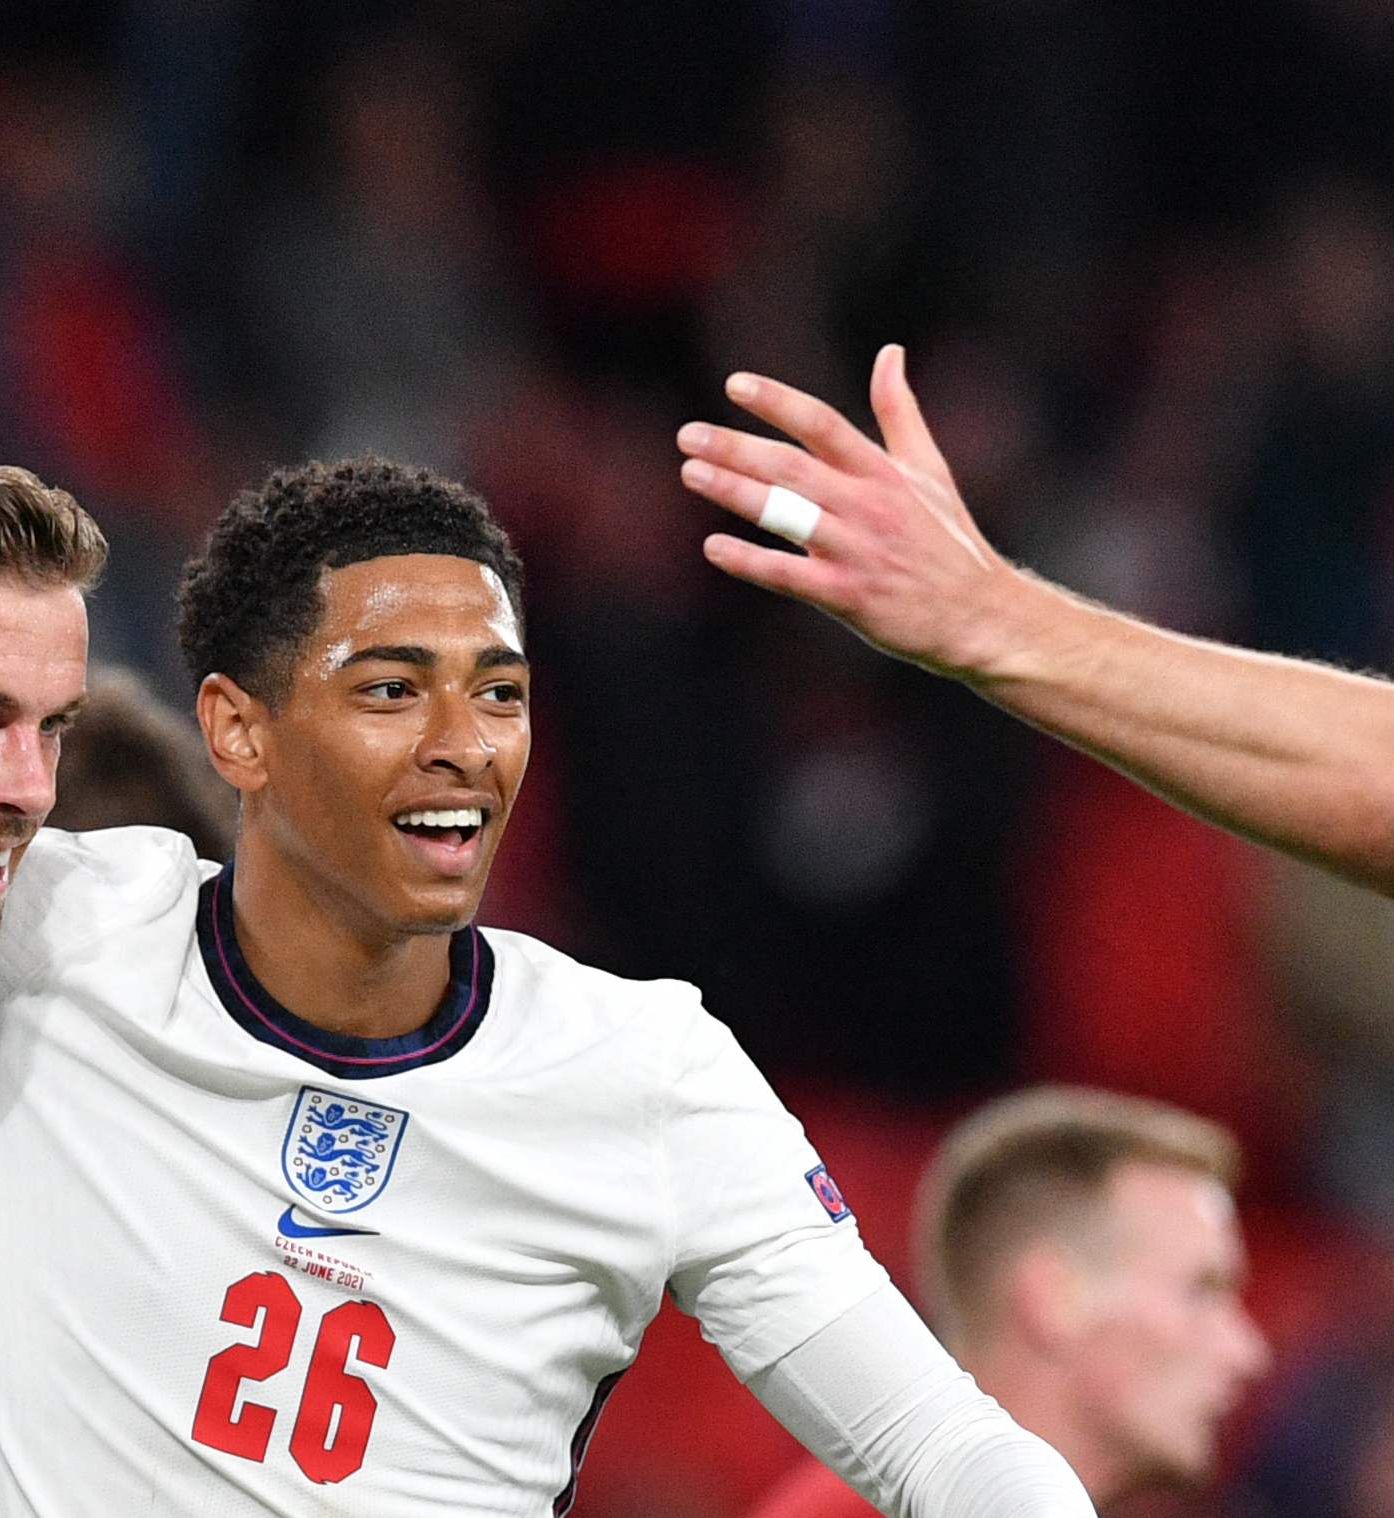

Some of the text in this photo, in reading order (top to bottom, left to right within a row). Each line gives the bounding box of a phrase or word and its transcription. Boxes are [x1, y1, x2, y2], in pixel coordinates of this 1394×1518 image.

[275, 1235, 374, 1280] CZECH REPUB
[301, 1261, 336, 1282] JUNE
[337, 1270, 365, 1291] 2021
[190, 1270, 397, 1486] 26
